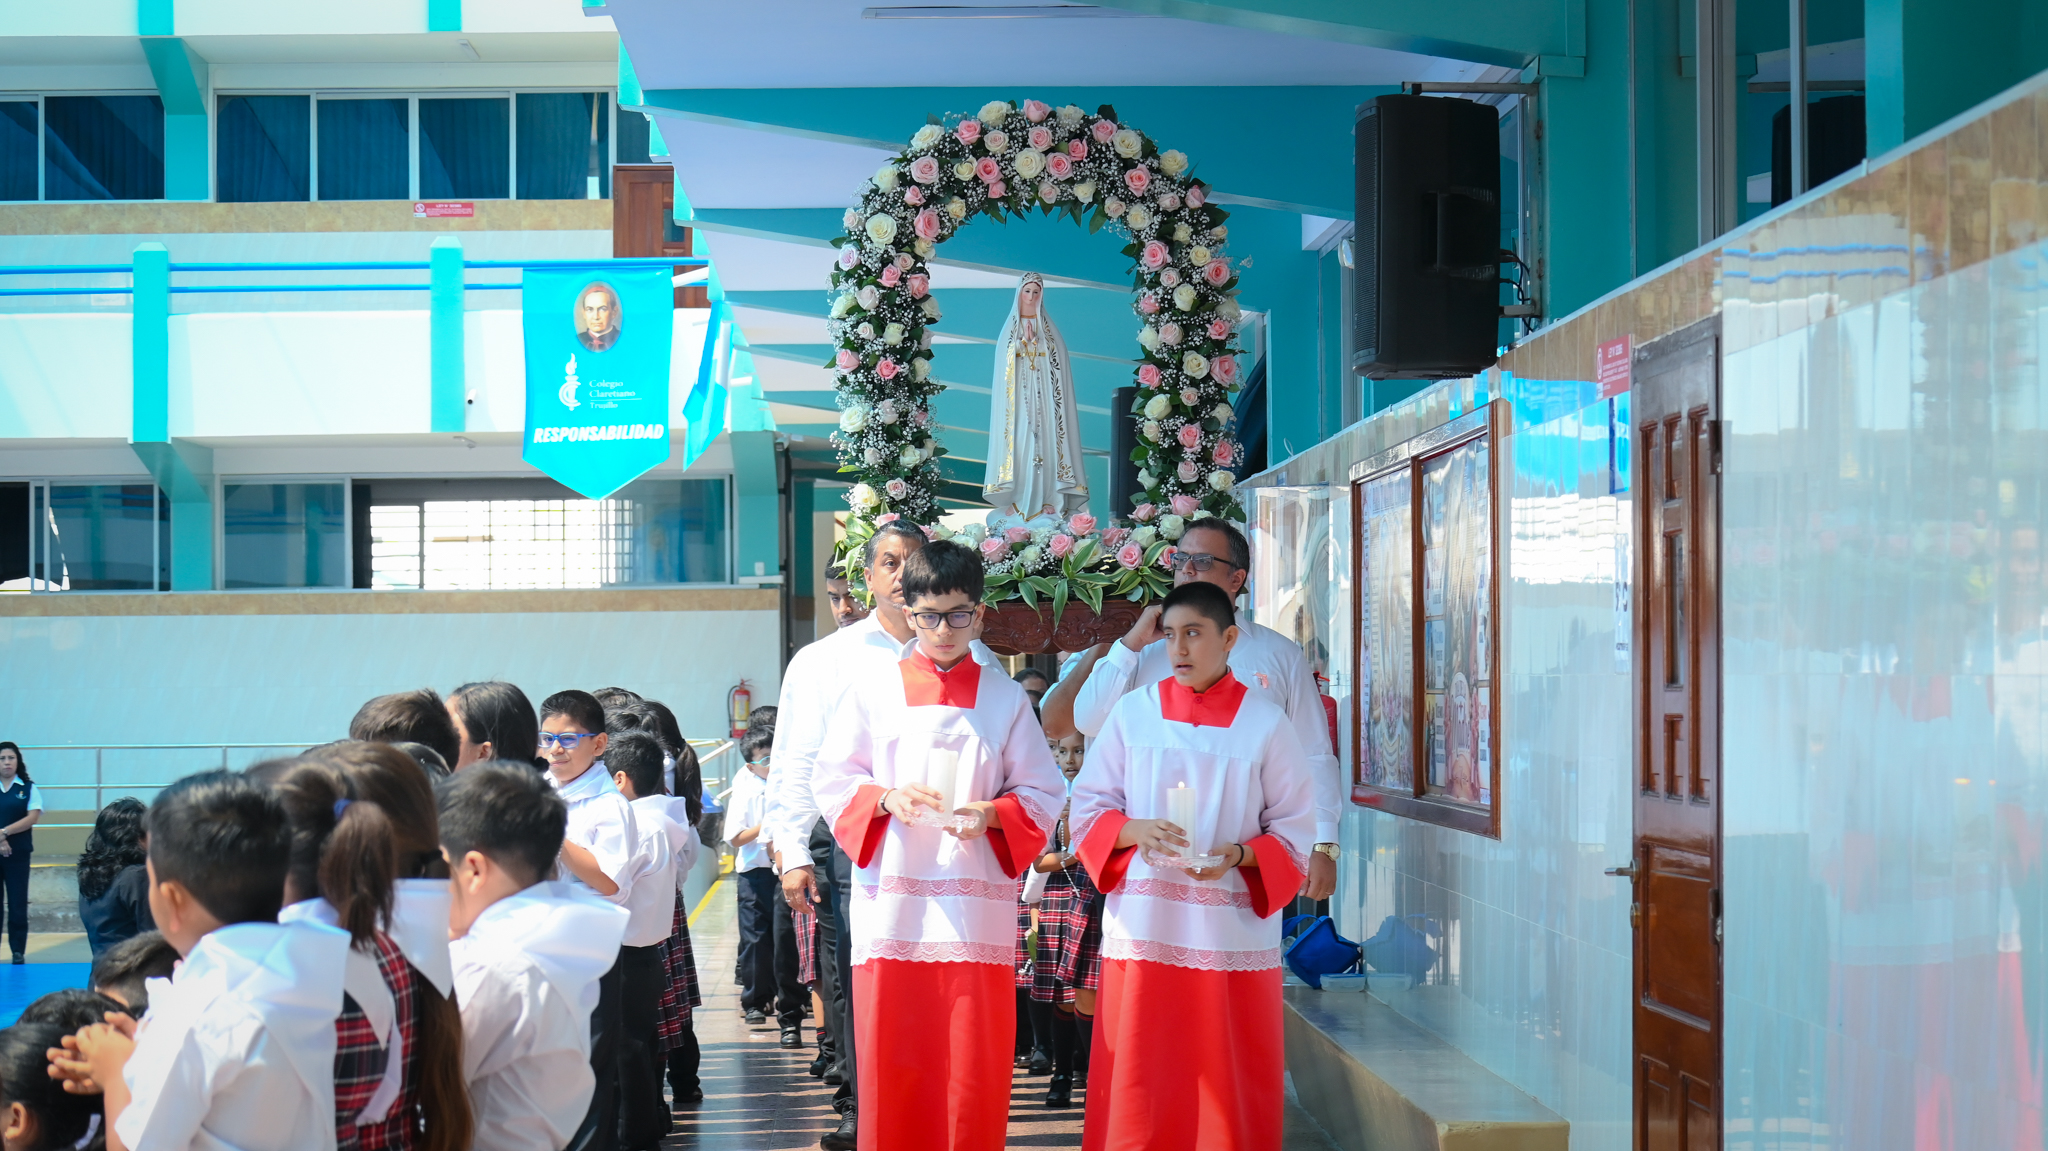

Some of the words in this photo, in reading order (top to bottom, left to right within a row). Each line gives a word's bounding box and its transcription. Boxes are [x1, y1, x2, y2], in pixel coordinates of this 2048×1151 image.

[589, 379, 624, 390] Colegio
[589, 389, 636, 398] Claretiano
[590, 401, 619, 410] Trujillo
[533, 424, 665, 444] RESPONSABILIDAD
